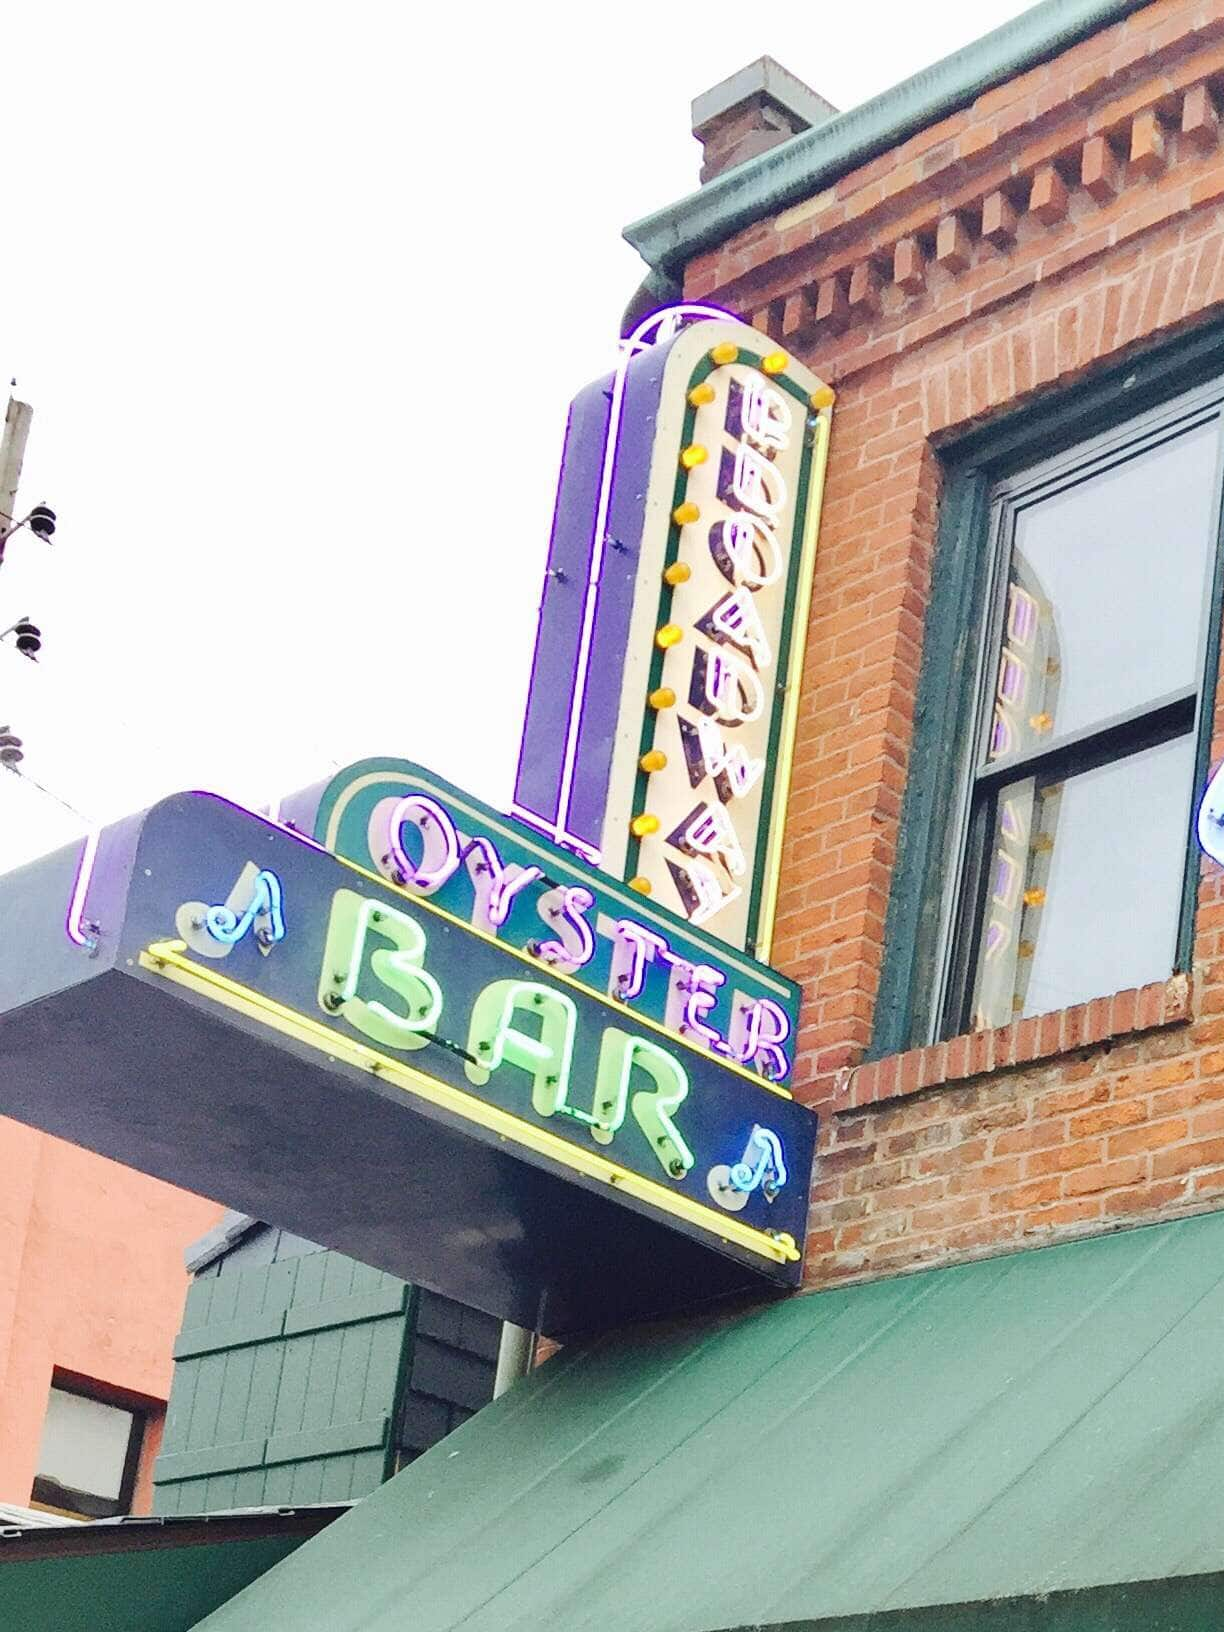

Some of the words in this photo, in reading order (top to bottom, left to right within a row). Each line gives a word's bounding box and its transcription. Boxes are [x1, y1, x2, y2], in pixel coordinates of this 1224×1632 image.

[665, 370, 793, 924] BROADWAY
[318, 888, 696, 1180] BAR
[368, 794, 791, 1083] OYSTER
